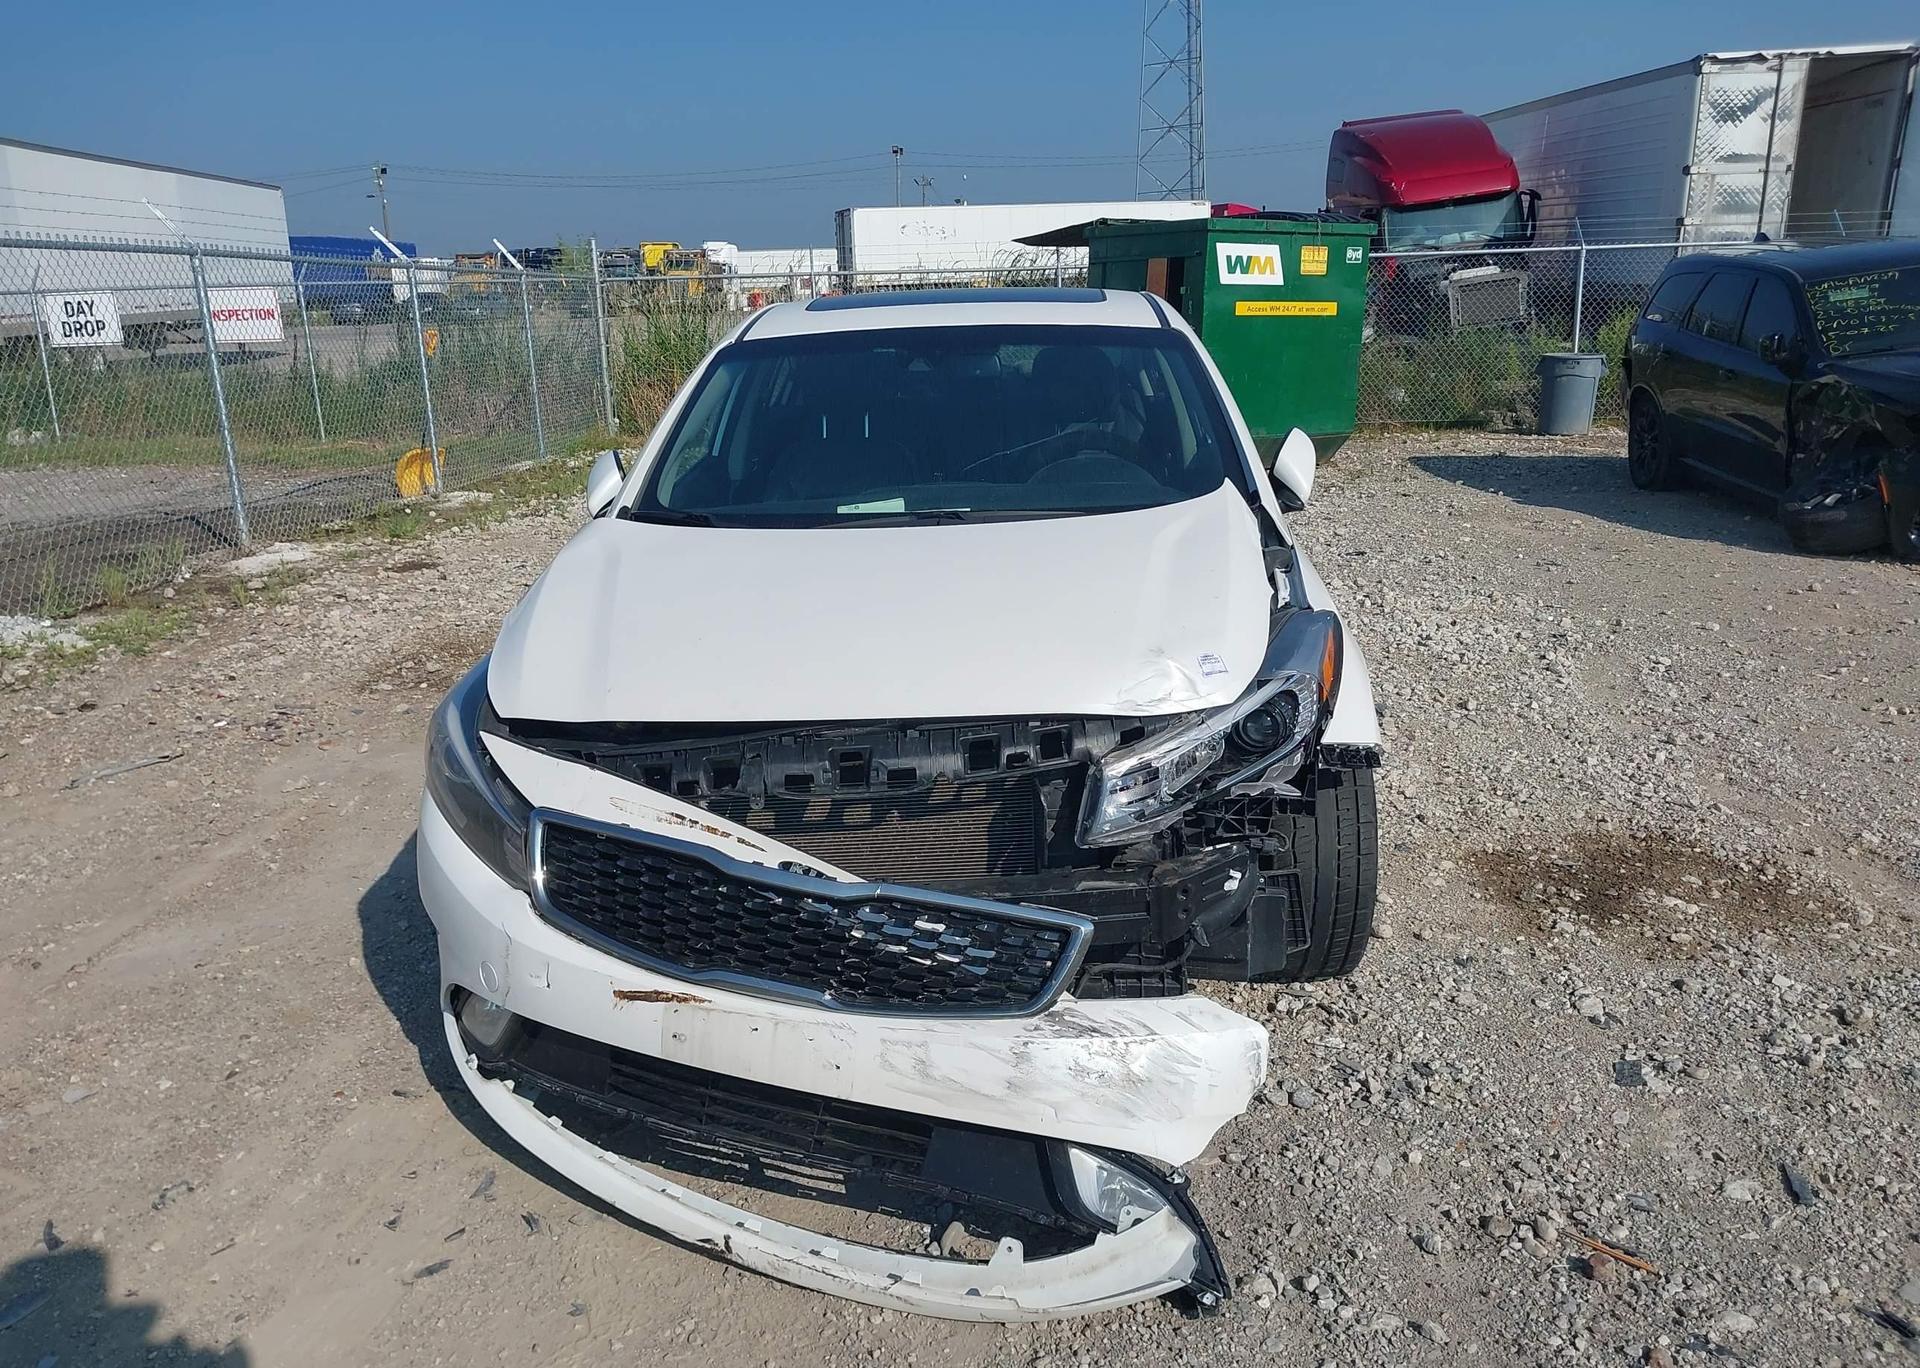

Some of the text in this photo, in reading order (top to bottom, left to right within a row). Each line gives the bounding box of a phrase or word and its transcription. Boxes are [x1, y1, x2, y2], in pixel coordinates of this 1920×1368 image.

[1226, 255, 1275, 275] WM
[64, 300, 94, 317] DAY
[212, 308, 276, 322] NSPECTION
[1247, 305, 1268, 313] Access
[1269, 305, 1281, 313] WM
[1282, 305, 1297, 313] 24/7
[61, 319, 106, 338] DROP
